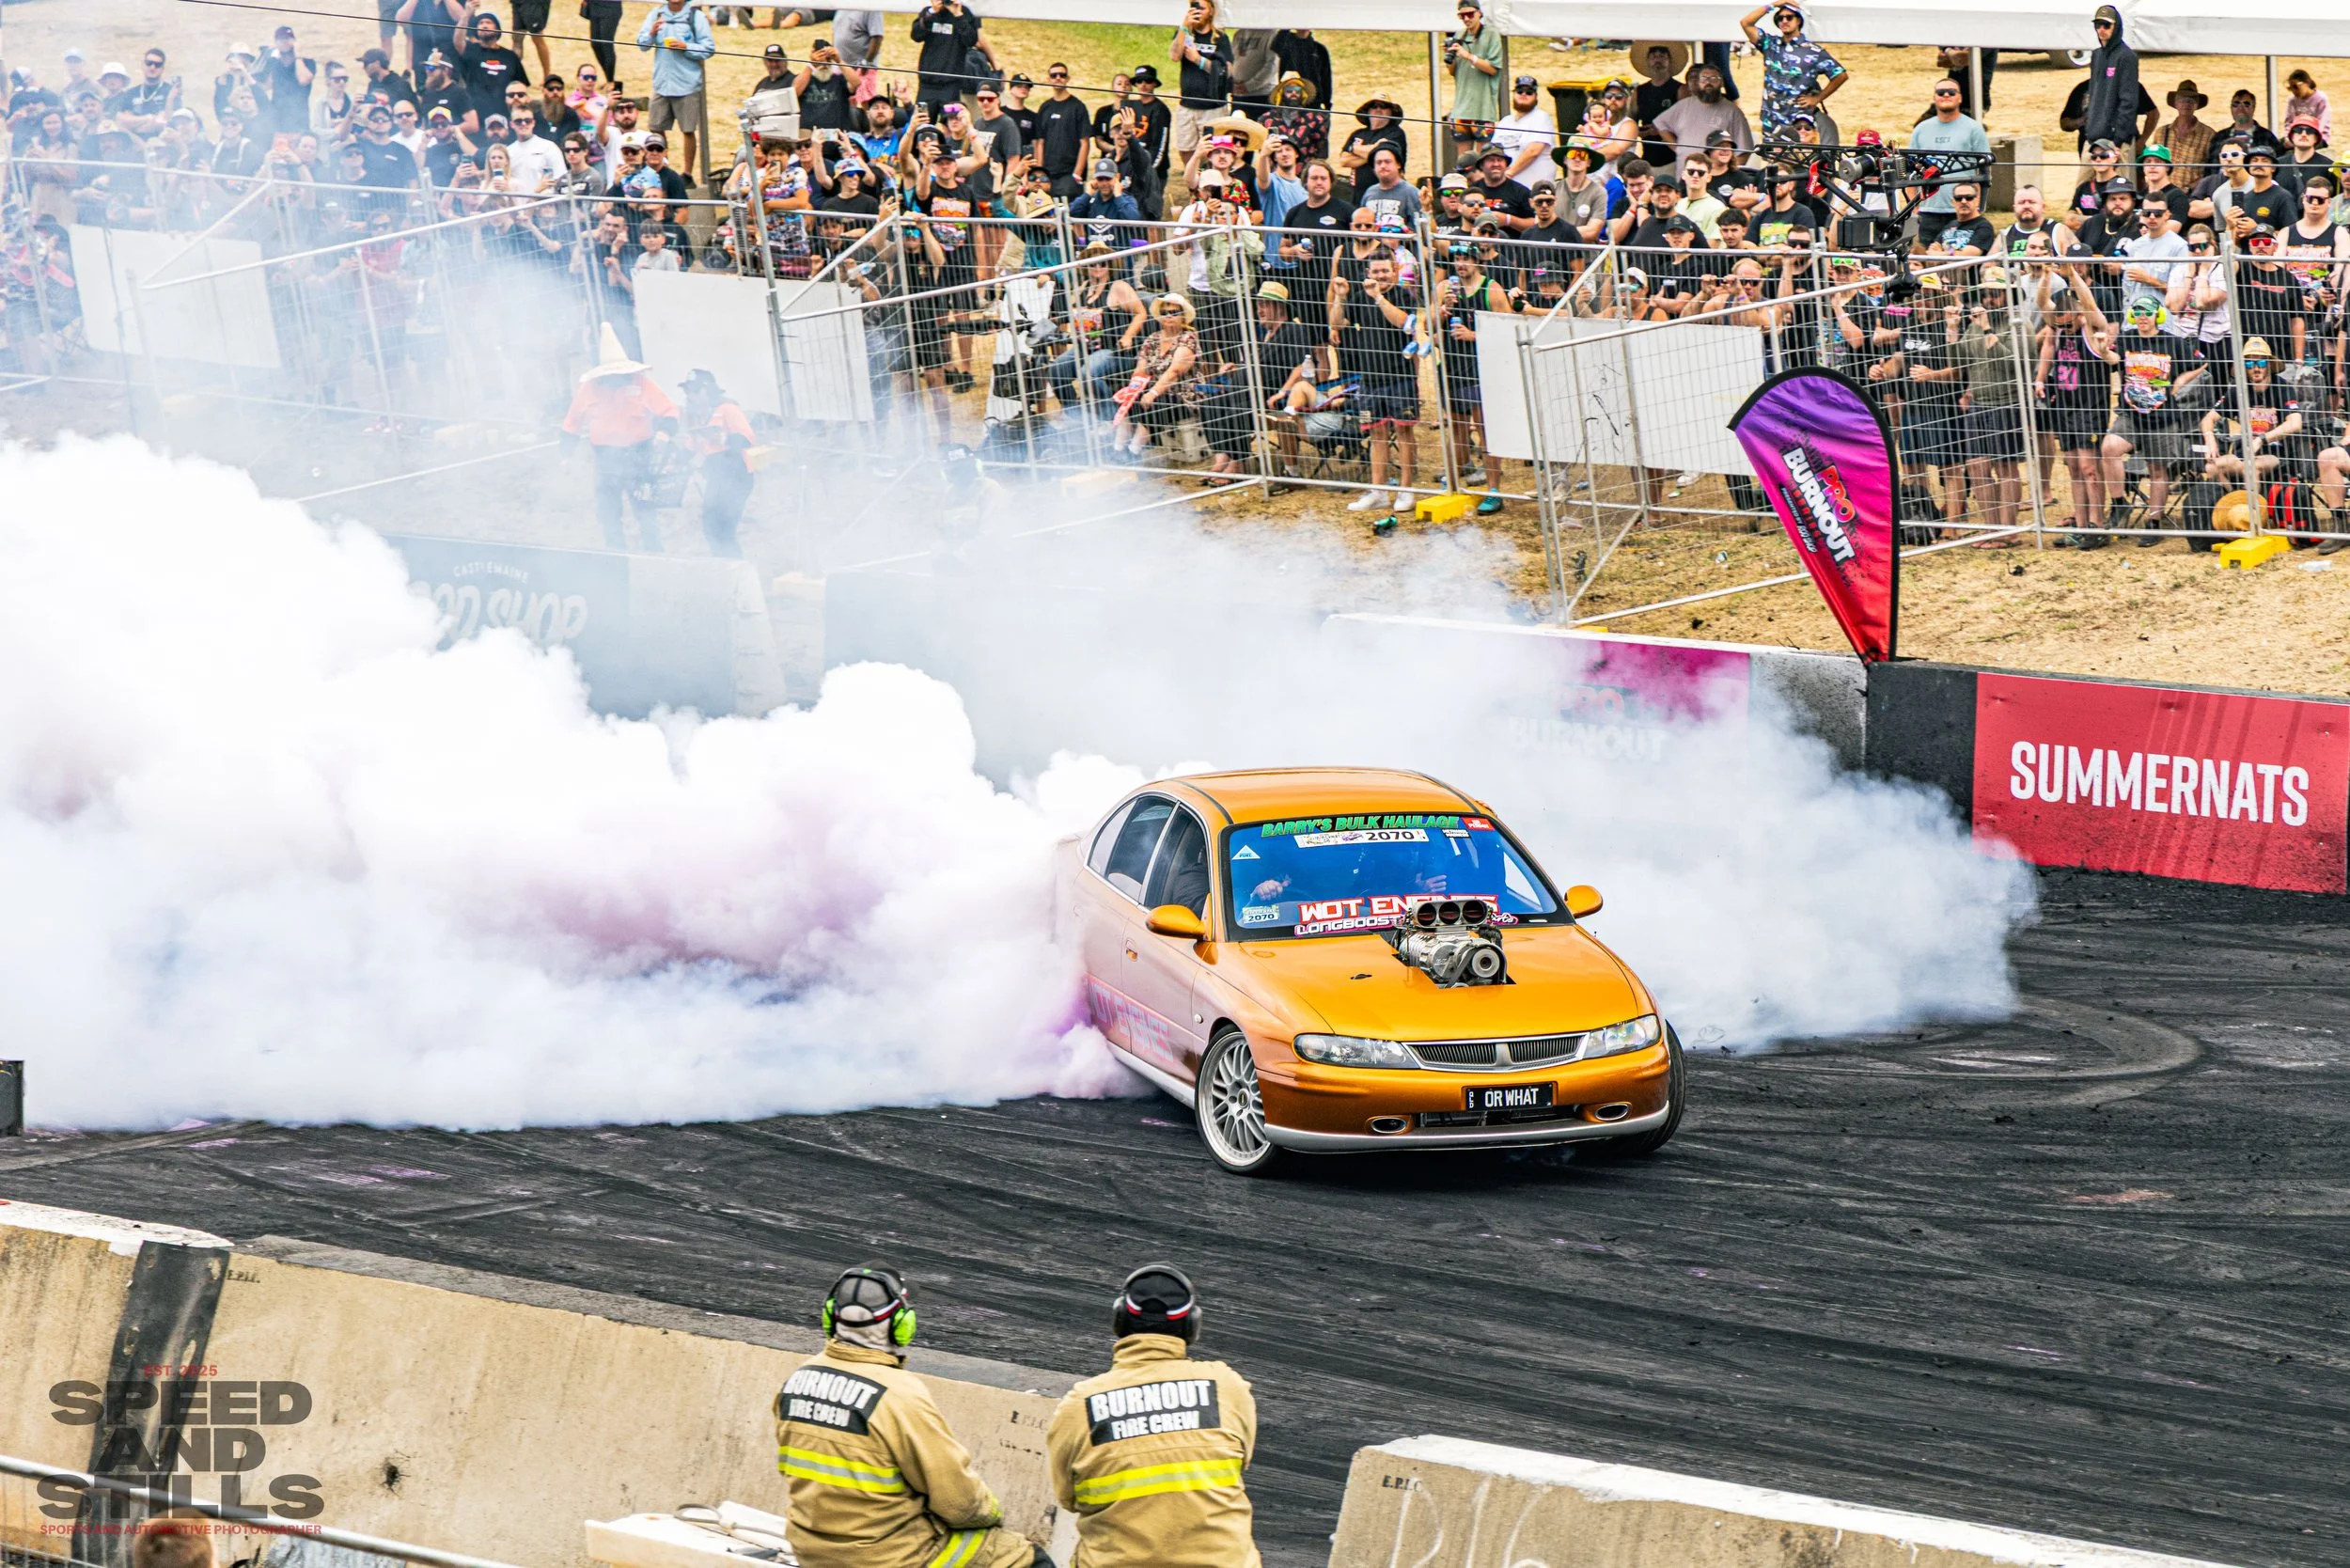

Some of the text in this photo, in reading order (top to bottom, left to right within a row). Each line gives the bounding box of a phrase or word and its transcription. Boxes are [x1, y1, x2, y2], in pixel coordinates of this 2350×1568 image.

[1783, 447, 1856, 561] BURNOUT
[1815, 465, 1856, 523] PRO
[453, 561, 530, 583] CASTLEMAINE
[1551, 685, 1625, 718] PRO
[1509, 717, 1669, 763] BURNOUT
[2010, 741, 2310, 827] SUMMERNATS
[1261, 819, 1332, 838] BARRY'S
[1335, 815, 1381, 830] BULK
[1383, 815, 1460, 828] HAULAGE
[1366, 831, 1415, 841] 2070
[1247, 914, 1275, 922] 2070
[1301, 899, 1362, 921] WOT
[1484, 1088, 1540, 1107] OR WHAT
[788, 1398, 851, 1427] FIRE CREW
[1089, 1380, 1211, 1422] BURNOUT
[1110, 1410, 1199, 1440] FIRE CREW
